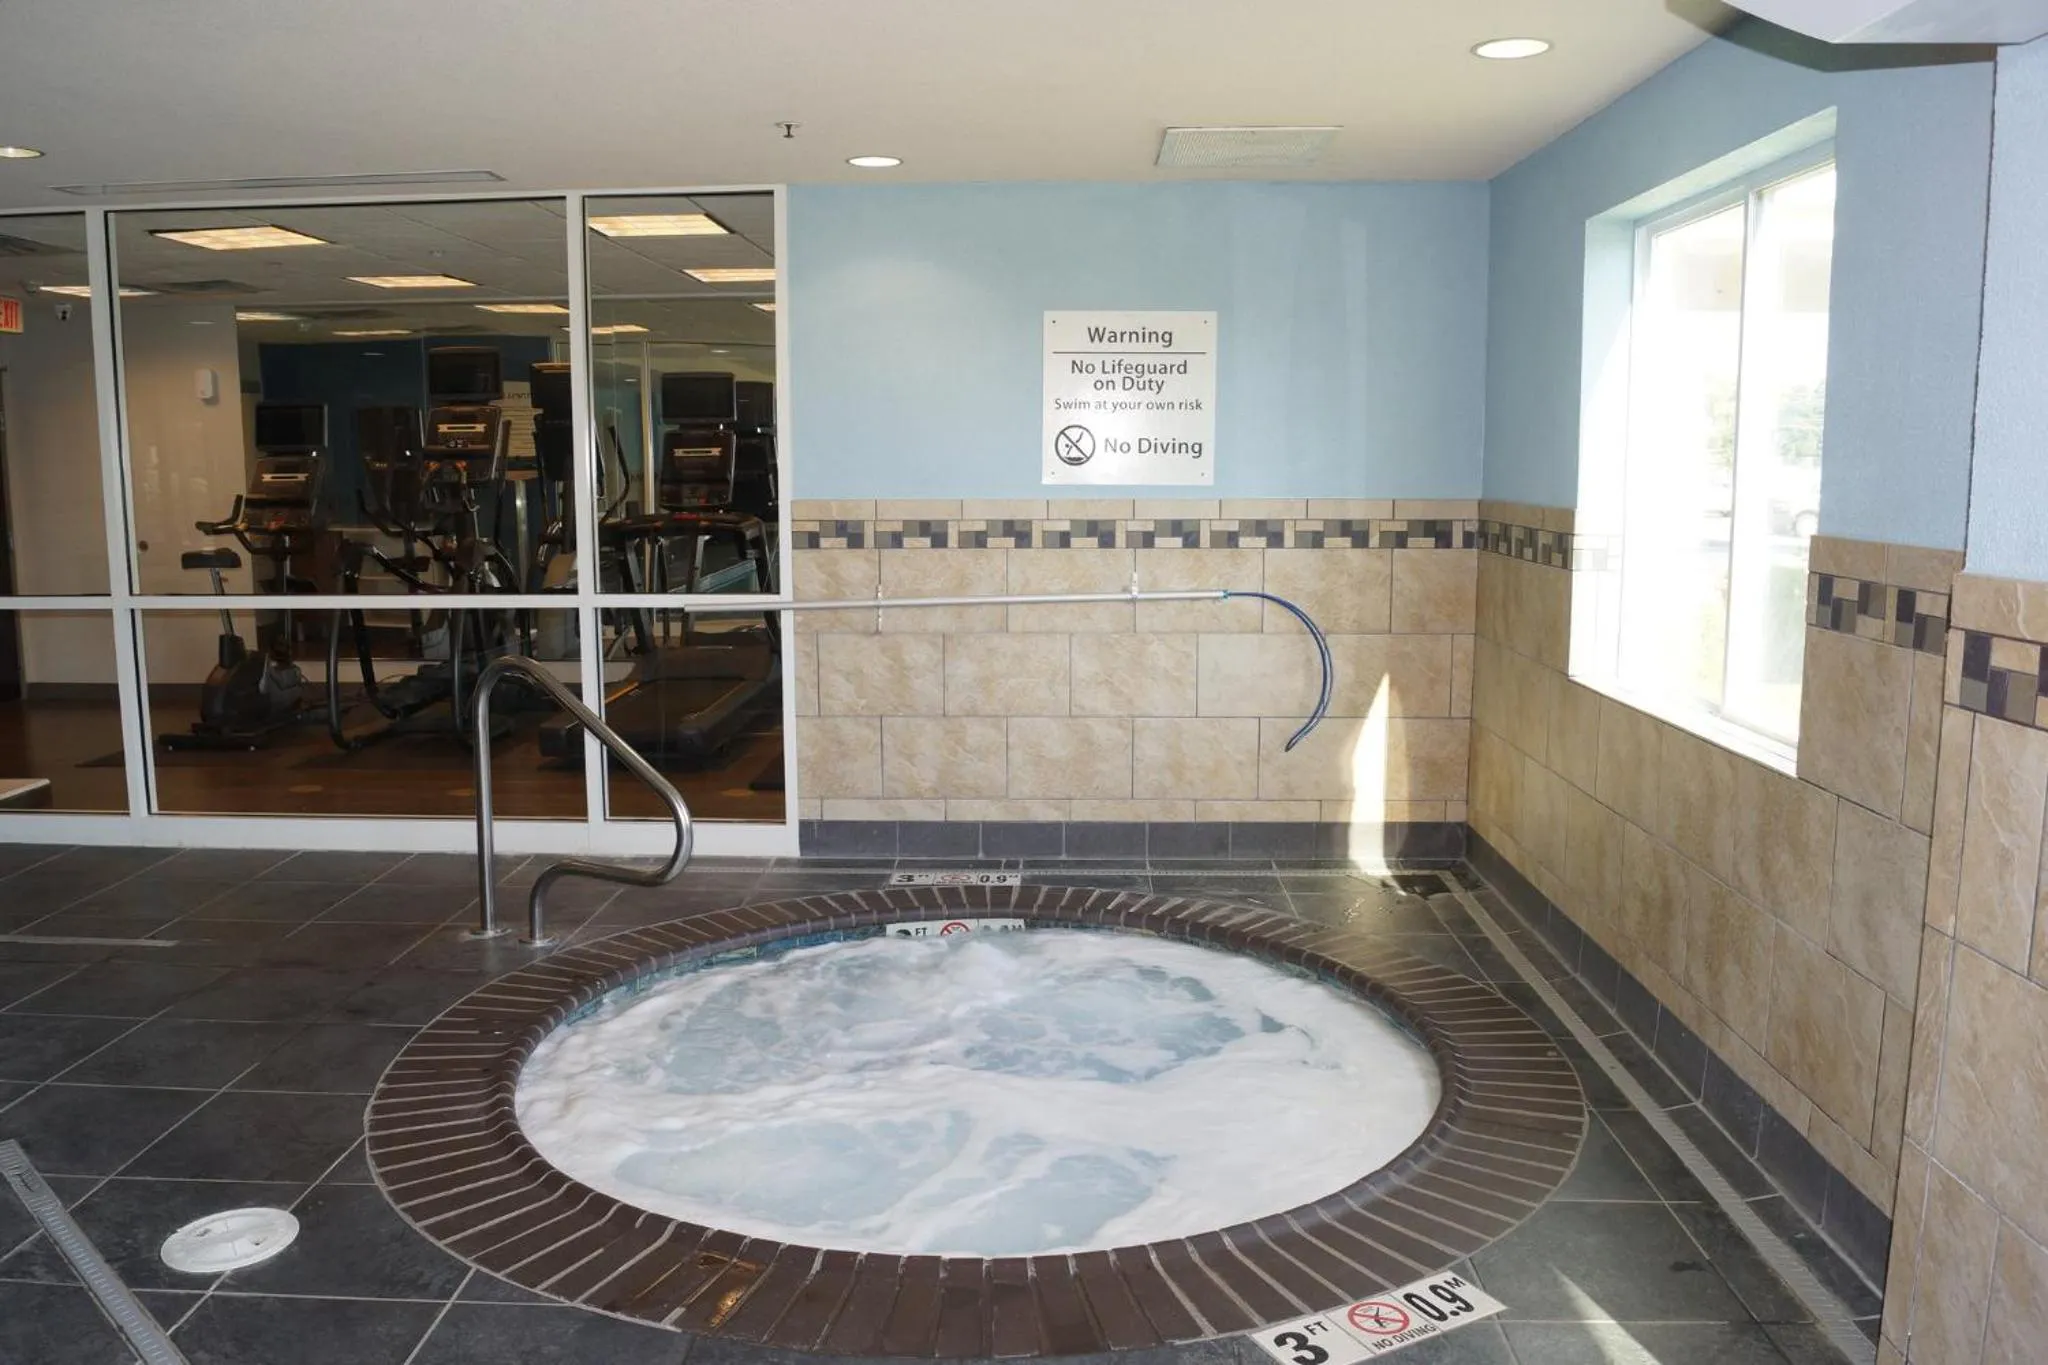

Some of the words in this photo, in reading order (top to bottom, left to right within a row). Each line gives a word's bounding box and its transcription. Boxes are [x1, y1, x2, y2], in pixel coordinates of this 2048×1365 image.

[1087, 327, 1173, 348] Warning
[1071, 359, 1095, 375] No
[1101, 359, 1188, 378] Lifeguard
[1093, 379, 1116, 391] on
[1122, 376, 1165, 395] Duty
[1054, 398, 1090, 411] Swim
[1094, 400, 1108, 411] at
[1111, 401, 1141, 413] your
[1146, 401, 1174, 411] own
[1178, 399, 1203, 411] risk
[1104, 437, 1131, 454] No
[1137, 437, 1203, 459] Diving
[896, 874, 915, 883] 3
[1371, 1338, 1394, 1351] NO
[1392, 1323, 1437, 1344] DIVING
